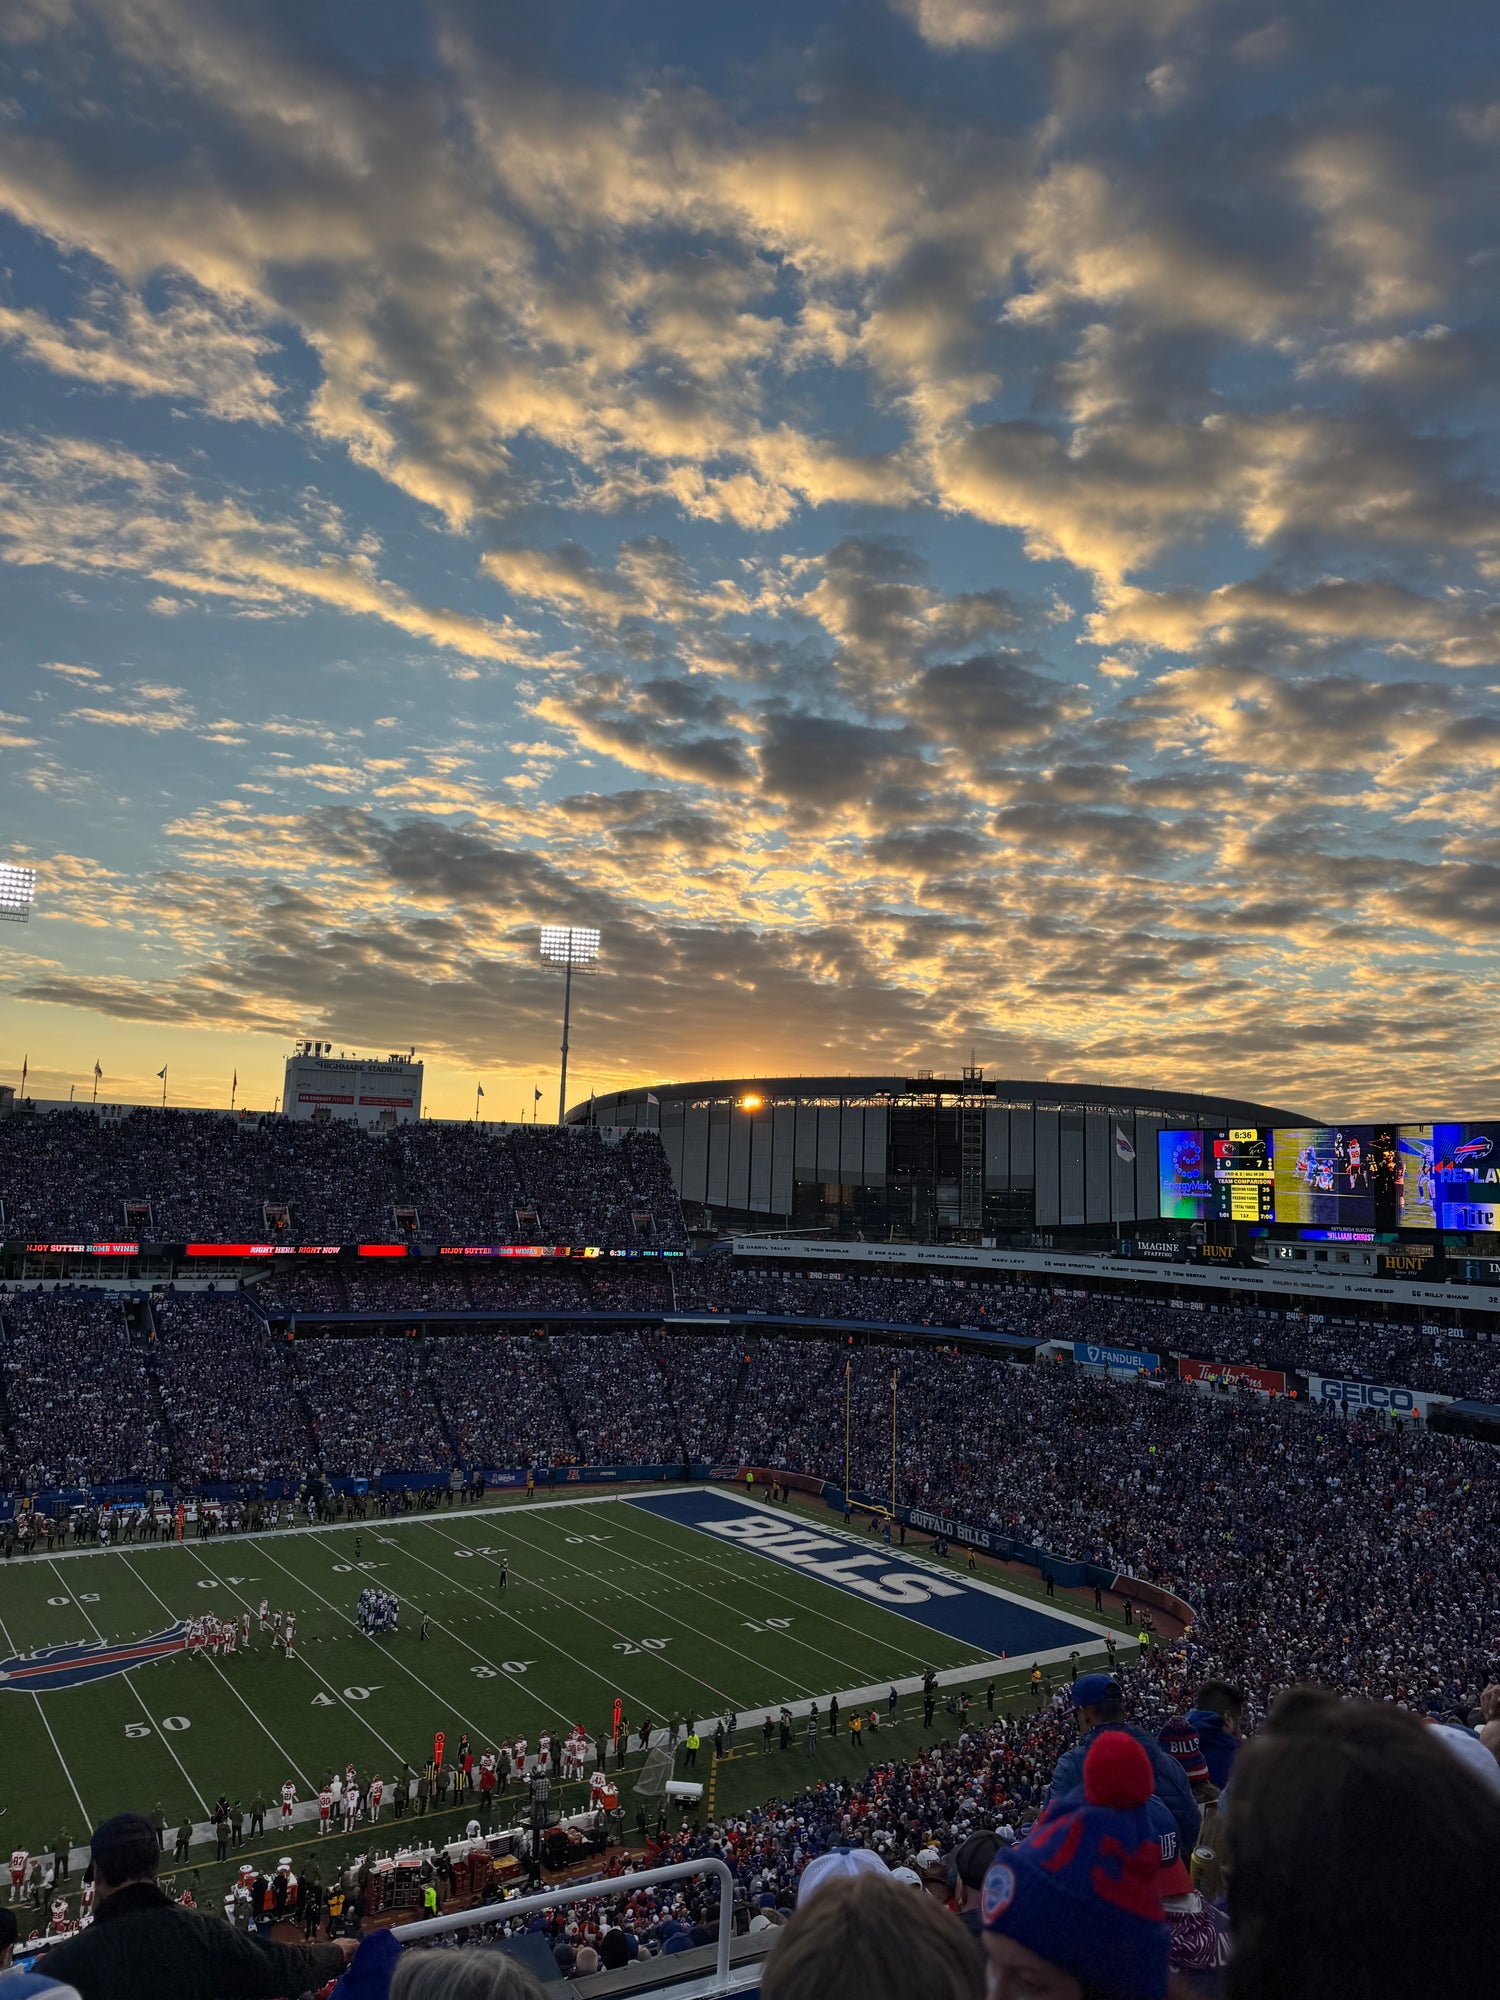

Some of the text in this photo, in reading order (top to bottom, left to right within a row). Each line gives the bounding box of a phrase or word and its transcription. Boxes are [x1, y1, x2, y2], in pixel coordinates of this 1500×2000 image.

[320, 1062, 403, 1075] HIGHMARK STADIUM
[1234, 1131, 1252, 1139] 6:36
[1225, 1160, 1262, 1168] 0 7
[1163, 1181, 1213, 1192] EnergyMark
[1461, 1208, 1495, 1228] Lite
[1327, 1231, 1352, 1240] WILLIAM
[50, 1244, 86, 1253] SUTTER
[86, 1244, 111, 1253] HOME
[112, 1244, 140, 1253] WINES
[250, 1246, 274, 1254] RIGHT
[298, 1247, 322, 1255] RIGHT
[322, 1247, 341, 1255] NOW
[440, 1247, 464, 1255] ENJOY
[464, 1247, 492, 1255] SUTTER
[1137, 1241, 1180, 1252] IMAGINE
[1202, 1245, 1235, 1258] HUNT
[1280, 1247, 1292, 1258] 21
[1385, 1256, 1424, 1271] HUNT
[952, 1280, 964, 1288] 42
[1170, 1299, 1204, 1311] 243 244
[1309, 1313, 1324, 1324] 200
[1422, 1325, 1465, 1338] 200 201
[1101, 1351, 1144, 1367] FANDUEL
[1320, 1379, 1414, 1411] GEICO
[909, 1510, 990, 1548] BUFFALO BILLS
[693, 1514, 969, 1605] BILLS
[822, 1526, 873, 1546] TAKES
[873, 1546, 907, 1559] ALL
[909, 1558, 935, 1570] OF
[938, 1570, 969, 1582] US
[740, 1617, 791, 1633] 10
[612, 1638, 667, 1656] 20
[469, 1660, 528, 1679] 30
[310, 1686, 371, 1707] 40
[124, 1716, 192, 1738] 50
[461, 1733, 468, 1743] 2
[1170, 1738, 1200, 1753] BILLS
[284, 1792, 292, 1801] 21
[321, 1797, 331, 1806] 30
[349, 1792, 356, 1801] 2
[800, 1832, 809, 1842] 12
[13, 1856, 24, 1866] 87
